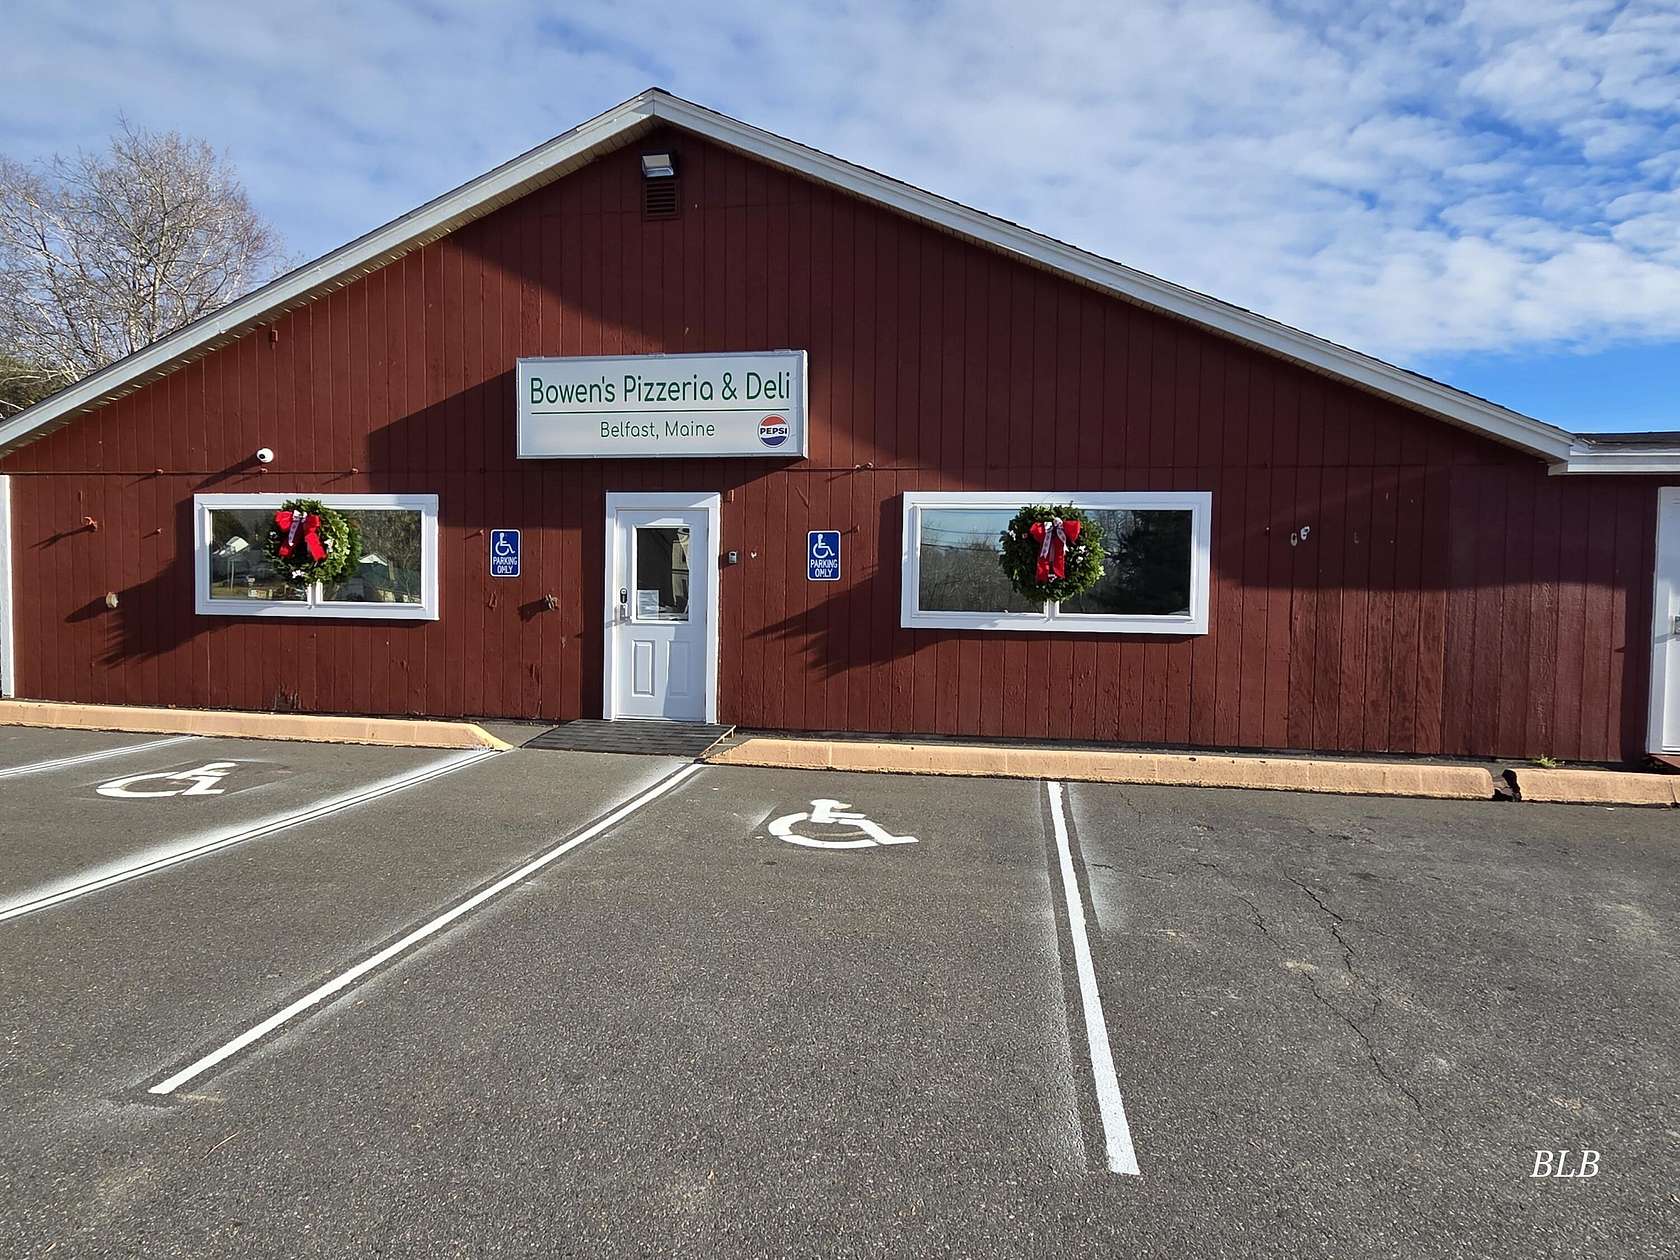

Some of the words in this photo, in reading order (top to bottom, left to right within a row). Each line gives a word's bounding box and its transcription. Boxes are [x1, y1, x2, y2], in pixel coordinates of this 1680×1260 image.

[530, 375, 615, 404] Bowen's
[624, 373, 714, 402] Pizzeria
[721, 371, 738, 401] &
[746, 371, 791, 400] Deli
[600, 421, 660, 440] Belfast,
[665, 420, 715, 438] Maine
[759, 427, 788, 436] PEPSI
[493, 556, 517, 565] PARKING
[810, 559, 838, 568] PARKING
[497, 565, 513, 574] ONLY
[815, 568, 832, 577] ONLY
